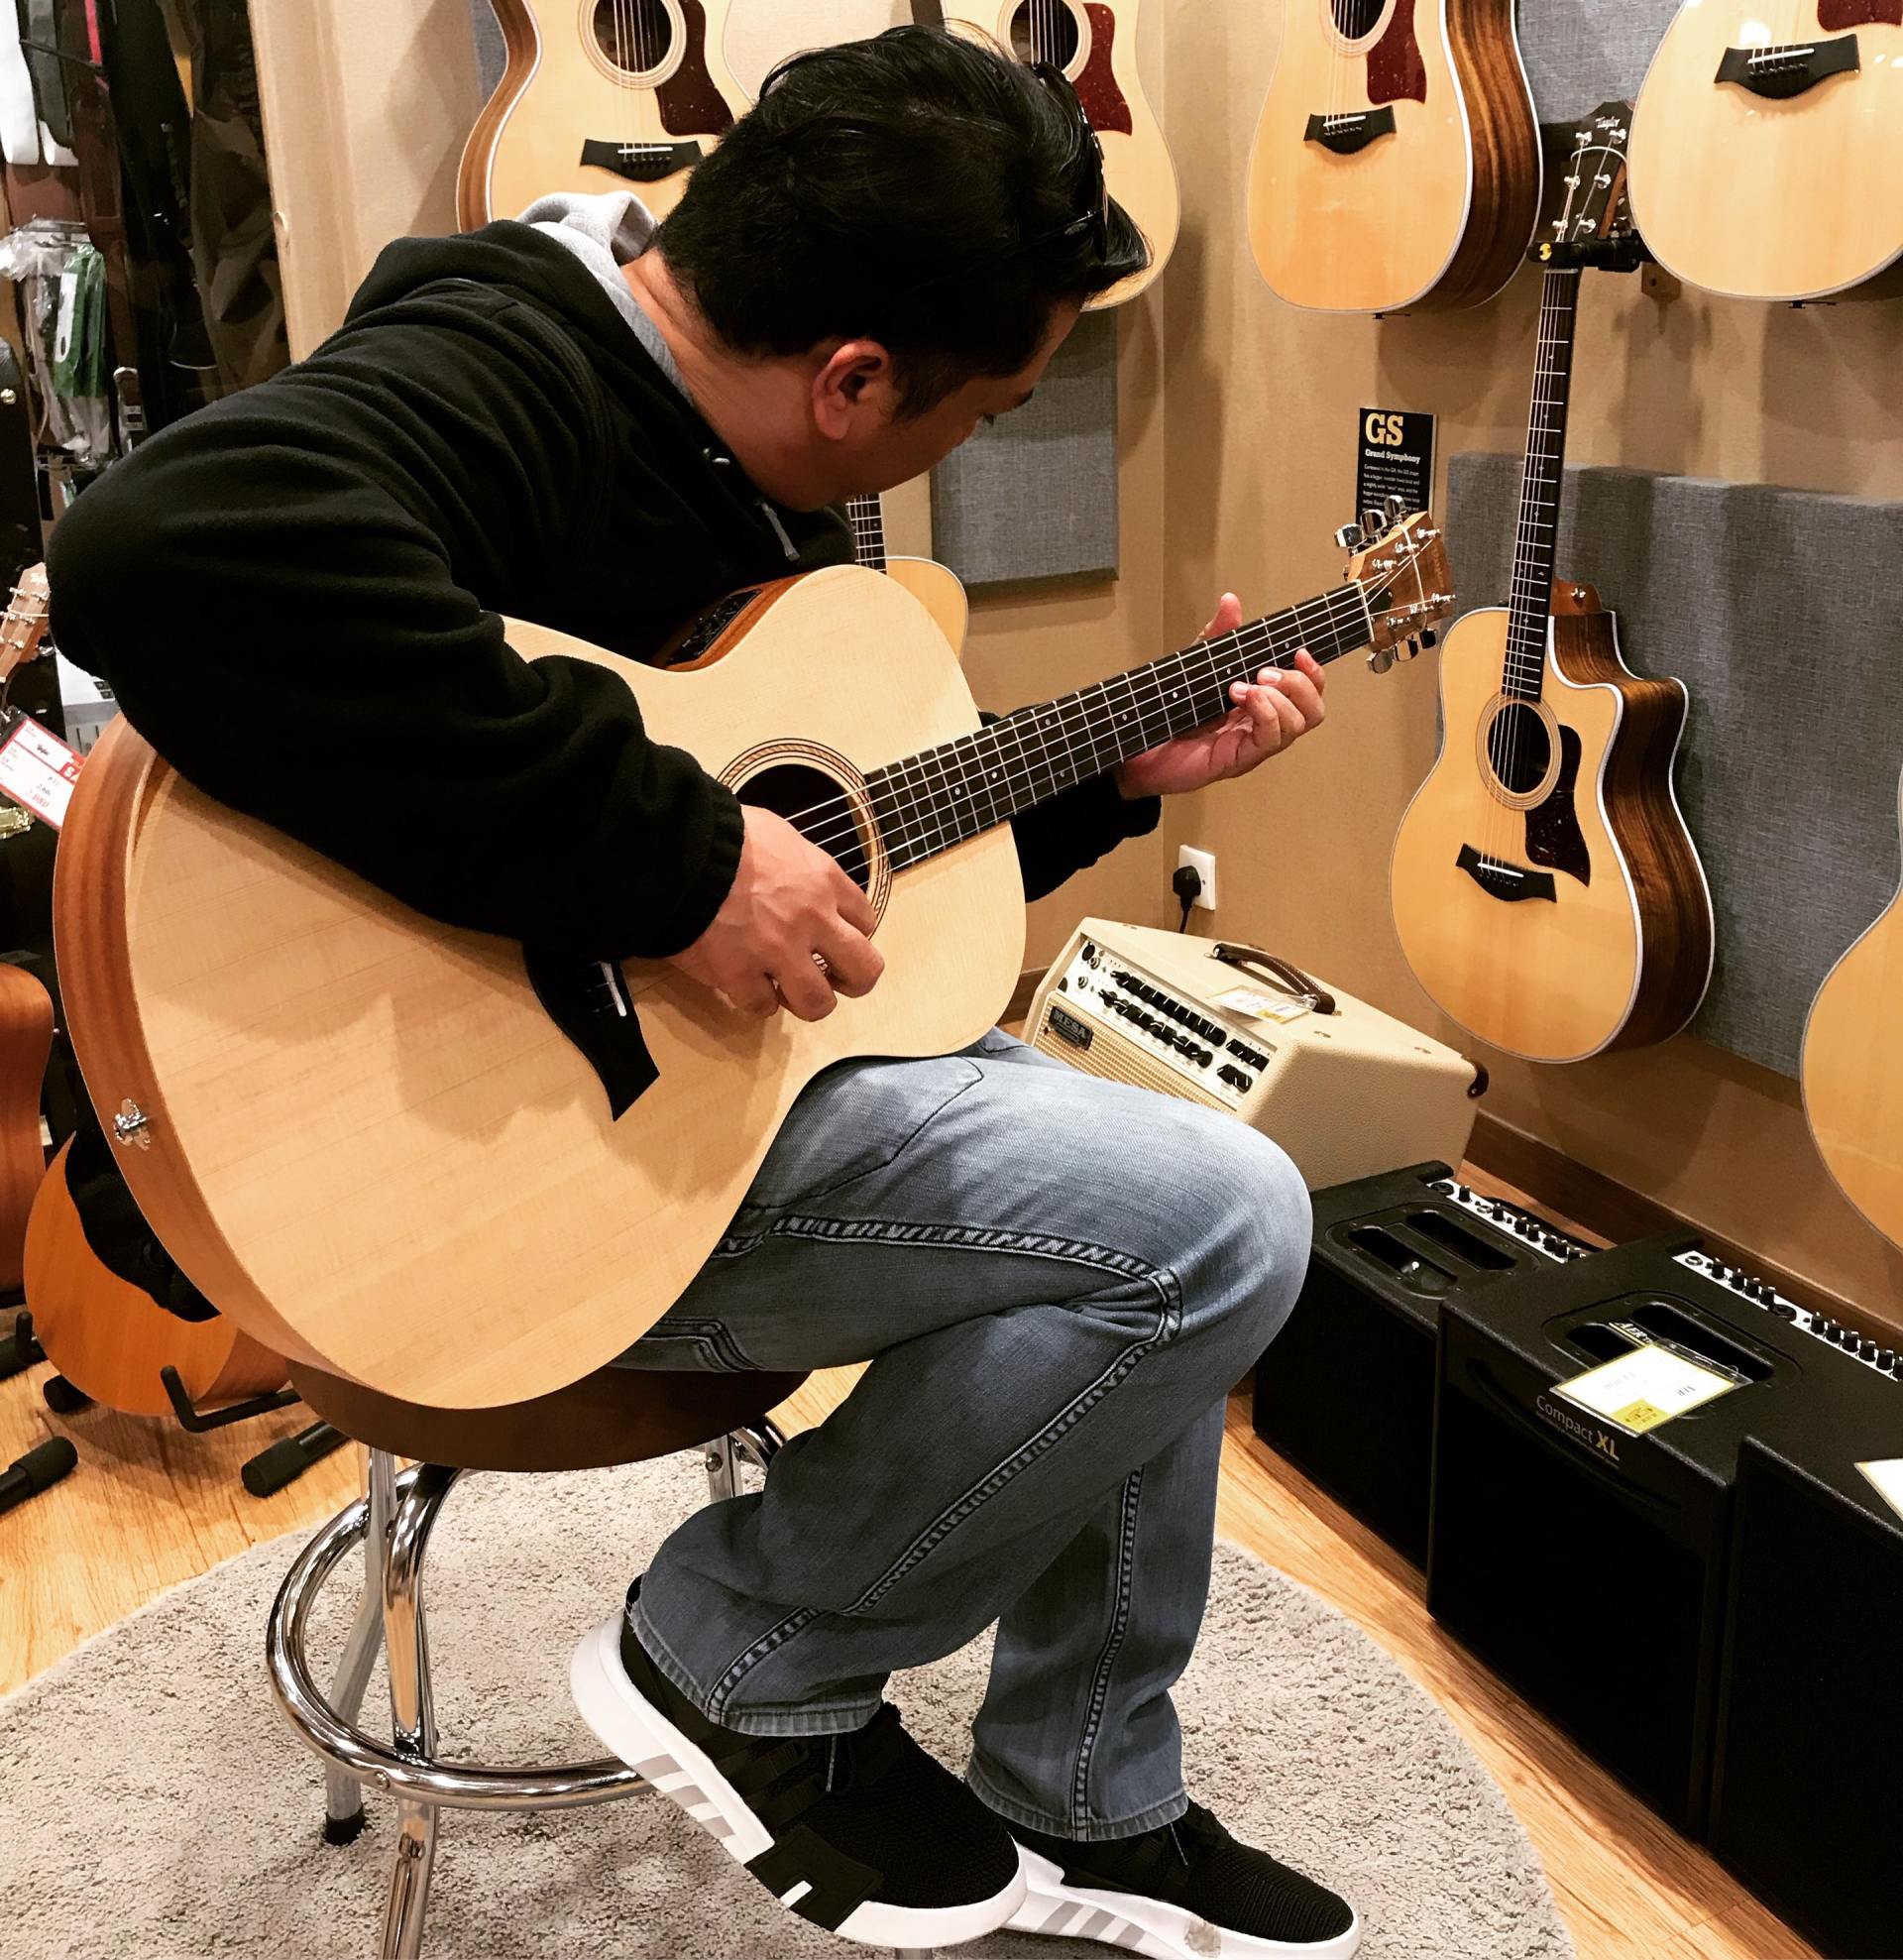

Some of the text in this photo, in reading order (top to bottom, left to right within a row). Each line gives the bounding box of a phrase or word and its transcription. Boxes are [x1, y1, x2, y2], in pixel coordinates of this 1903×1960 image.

[1365, 412, 1404, 446] GS
[1365, 448, 1421, 464] Grand Symphony
[1053, 1009, 1087, 1039] MESA
[1536, 1395, 1593, 1443] Compact
[1596, 1430, 1620, 1461] XL
